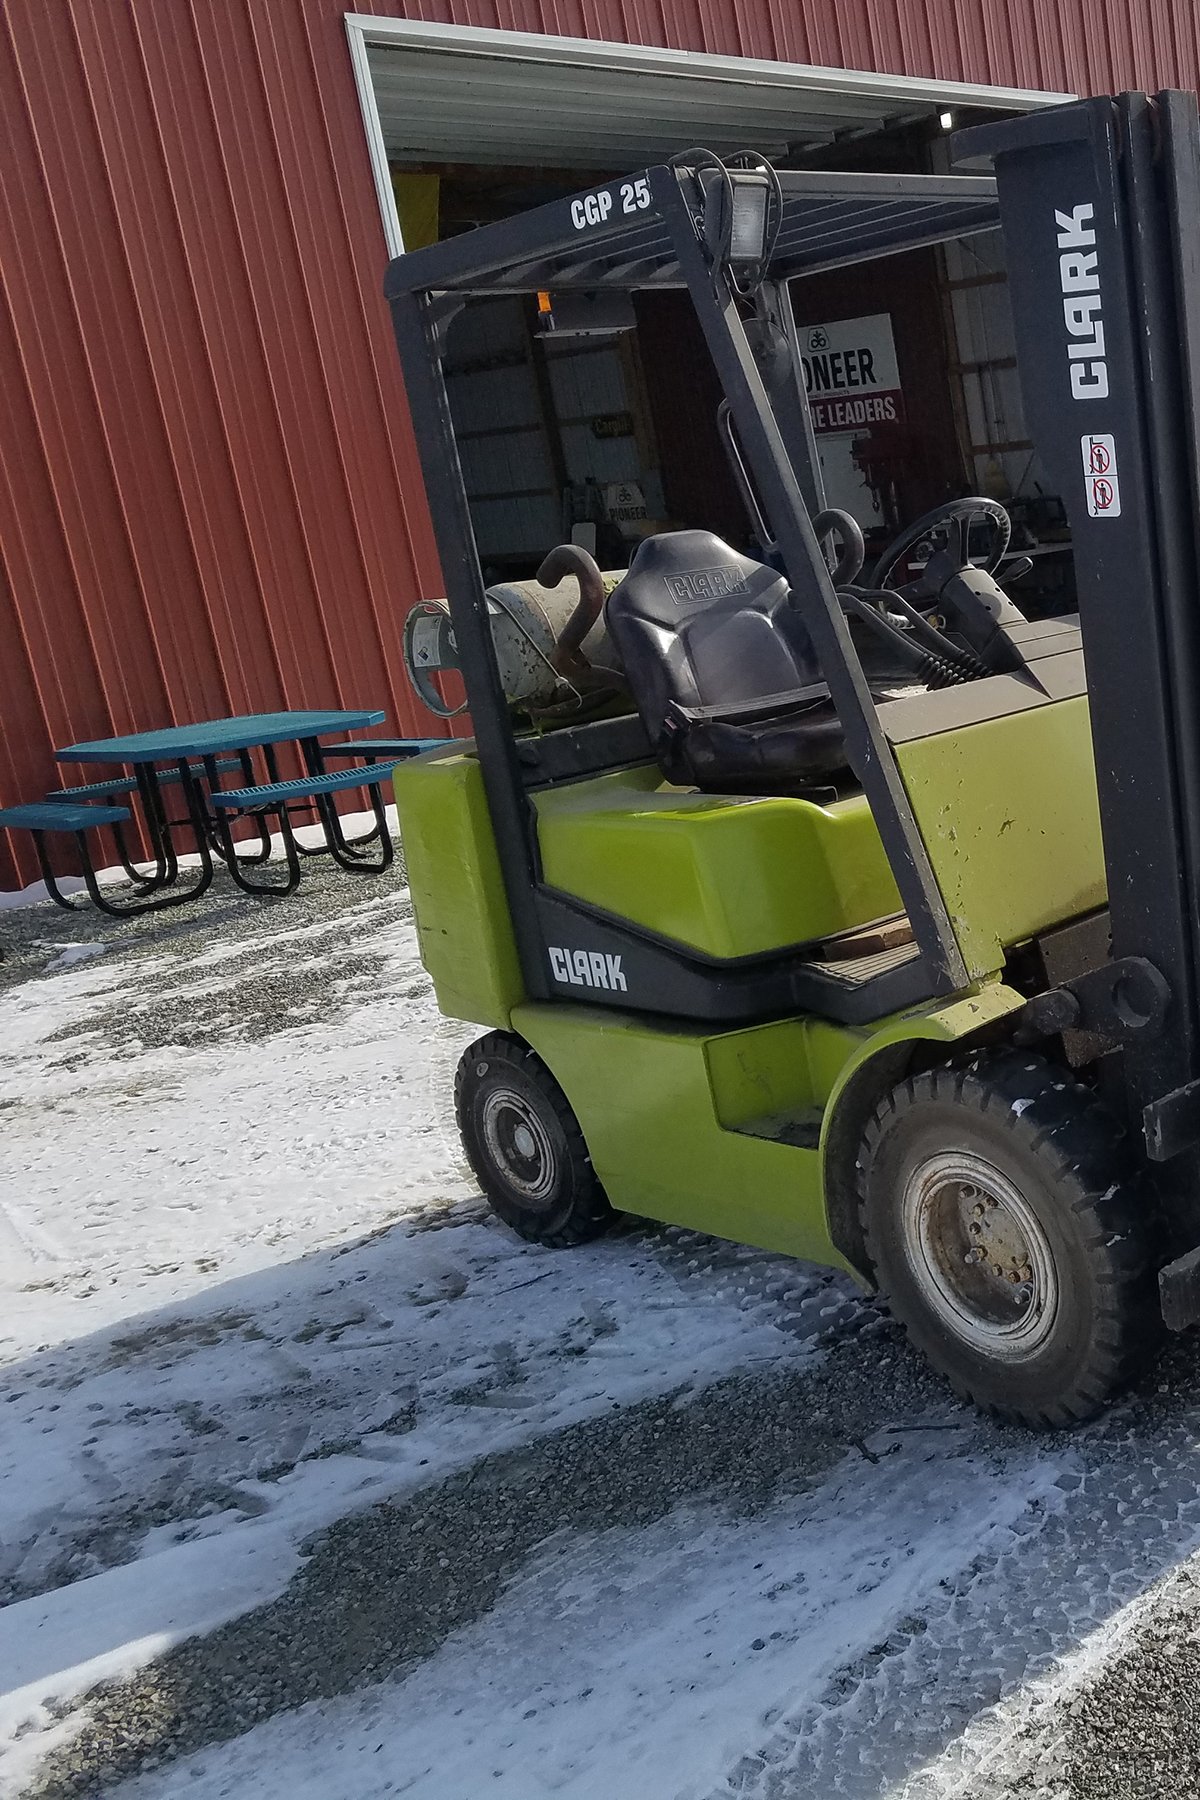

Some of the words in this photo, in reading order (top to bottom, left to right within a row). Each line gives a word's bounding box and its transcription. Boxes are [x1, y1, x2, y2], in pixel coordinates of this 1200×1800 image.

[571, 191, 612, 230] CGP
[620, 179, 650, 214] 25
[1054, 203, 1109, 400] CLARK
[828, 396, 896, 427] LEADERS
[608, 506, 648, 521] PIONEER
[668, 568, 747, 602] CLARK
[548, 947, 628, 991] CLARK
